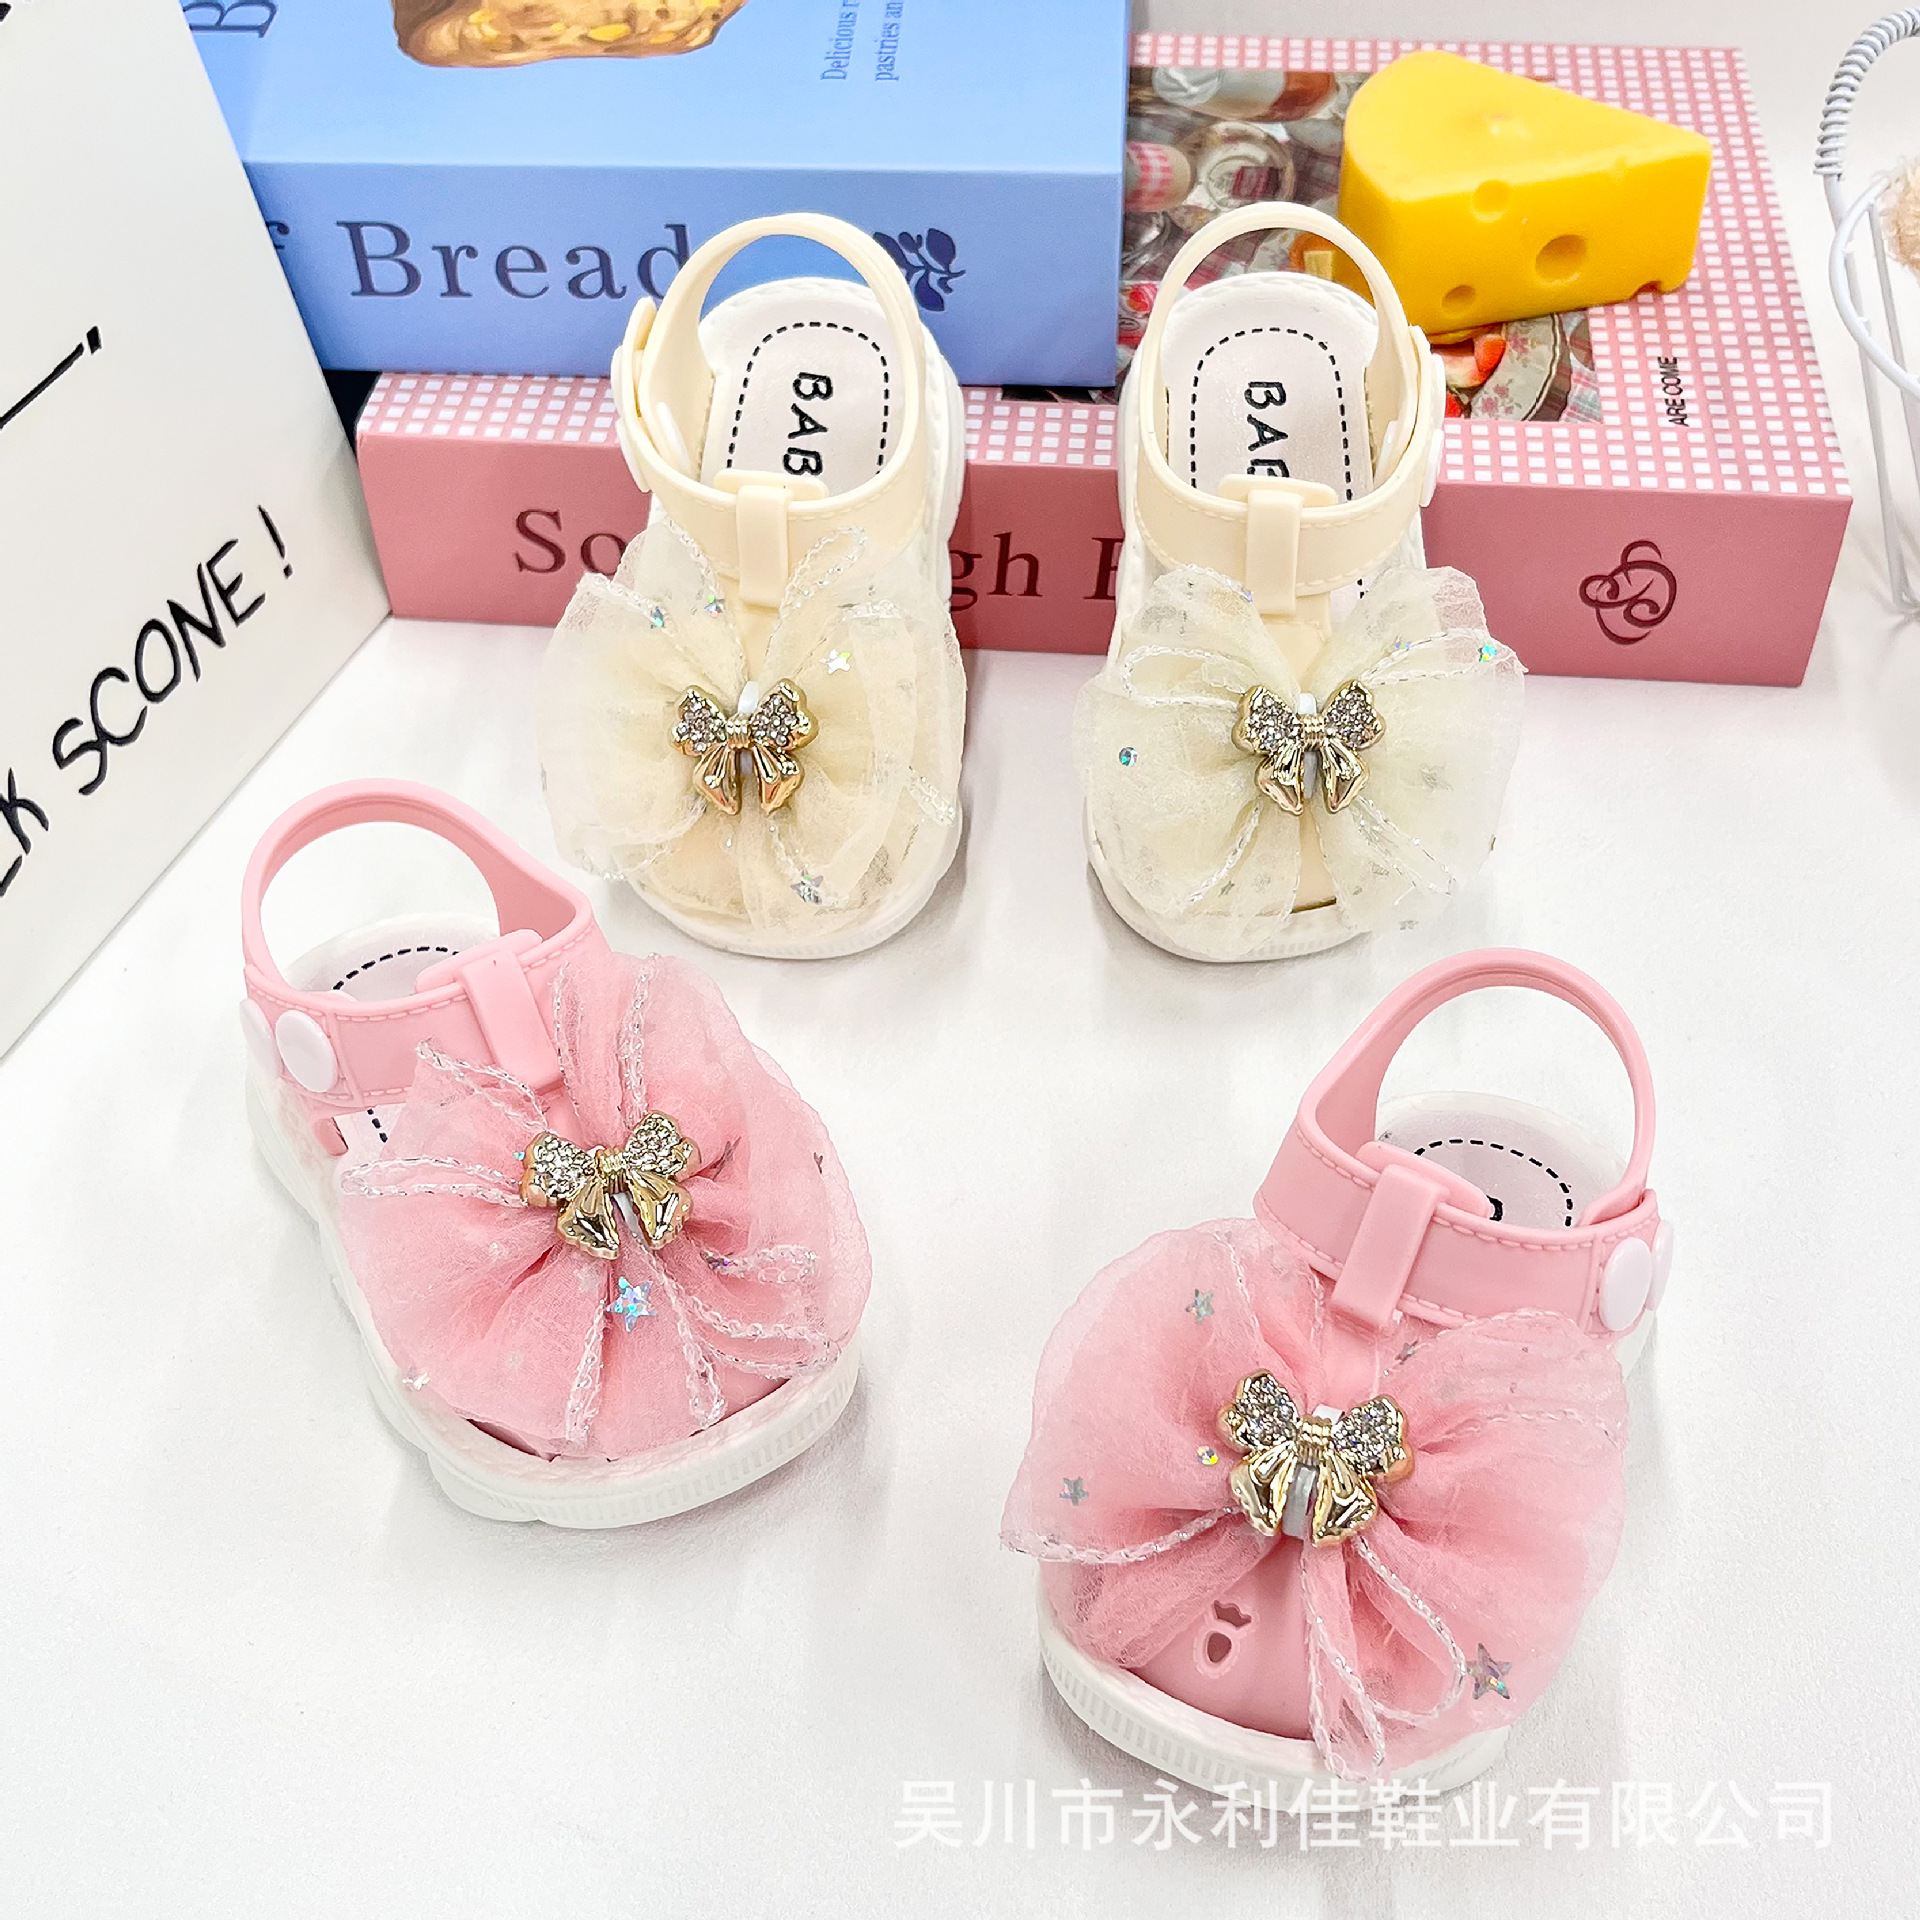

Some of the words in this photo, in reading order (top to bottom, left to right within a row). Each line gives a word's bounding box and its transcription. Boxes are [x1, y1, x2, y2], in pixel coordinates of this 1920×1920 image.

[820, 11, 858, 80] Delicious
[873, 22, 901, 81] pastries
[336, 220, 692, 300] Bread
[1657, 356, 1684, 397] COME
[1664, 398, 1690, 428] ARE
